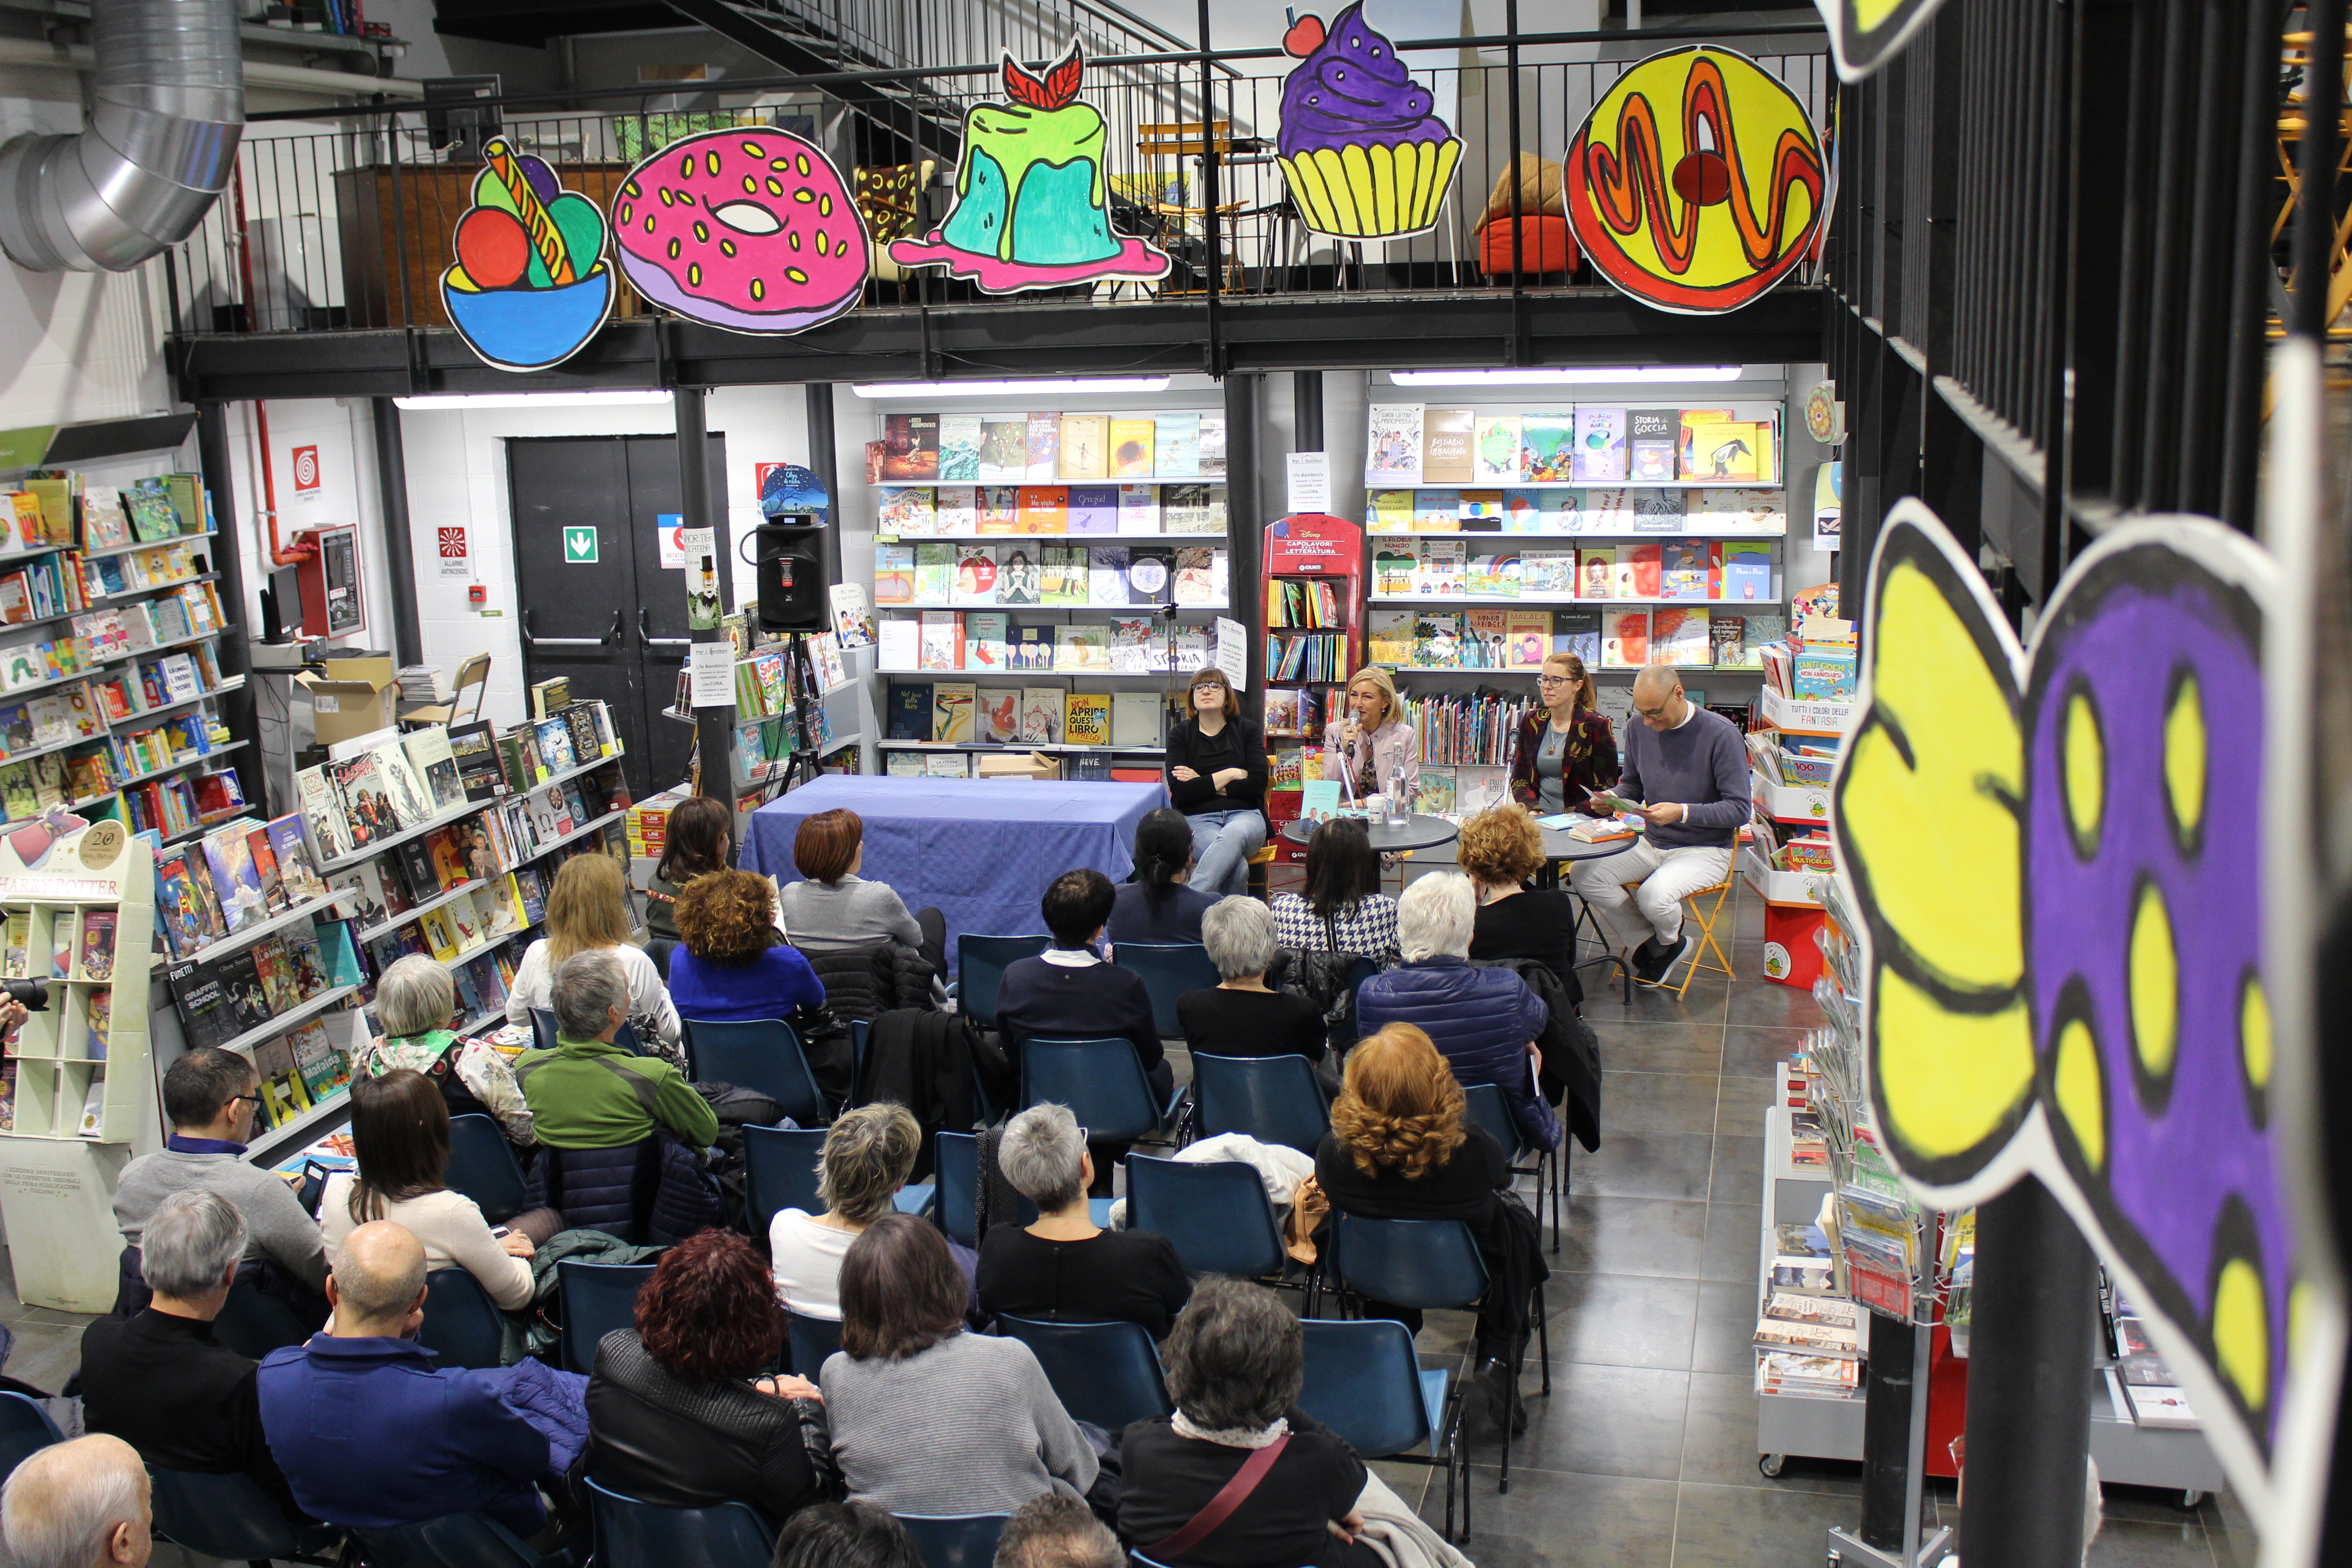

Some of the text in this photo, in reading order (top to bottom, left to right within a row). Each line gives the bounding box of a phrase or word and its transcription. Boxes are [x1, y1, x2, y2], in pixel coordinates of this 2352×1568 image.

[1635, 416, 1659, 424] STORIA
[1635, 424, 1667, 435] GOCCIA
[1431, 438, 1464, 447] BESTIARIO
[1430, 447, 1466, 456] IMMAGINATO
[786, 471, 798, 480] Olga
[901, 491, 931, 502] DETECTIVE
[1078, 495, 1106, 506] Grazie!
[760, 660, 780, 675] SUPER
[1798, 662, 1845, 671] TANTI GIOCHI
[763, 669, 782, 686] COLOR
[1071, 698, 1089, 710] NON
[1791, 705, 1807, 713] TUTTI
[1832, 707, 1848, 715] DELLA
[1802, 715, 1838, 726] FANTASIA
[1070, 725, 1099, 734] LIBRO
[1076, 730, 1101, 742] PREGO!
[1079, 758, 1100, 766] NEVE
[338, 761, 376, 784] LA CREPA
[92, 832, 114, 845] 20
[1791, 846, 1833, 858] MAXI
[1793, 857, 1833, 865] MULTICOLOR
[0, 877, 118, 895] HARRY POTTER
[399, 926, 416, 936] CORPO
[219, 956, 251, 973] Ghost Stories
[185, 980, 219, 1001] GRAFFITI
[188, 990, 220, 1009] SCHOOL
[303, 1054, 340, 1079] Mafalda
